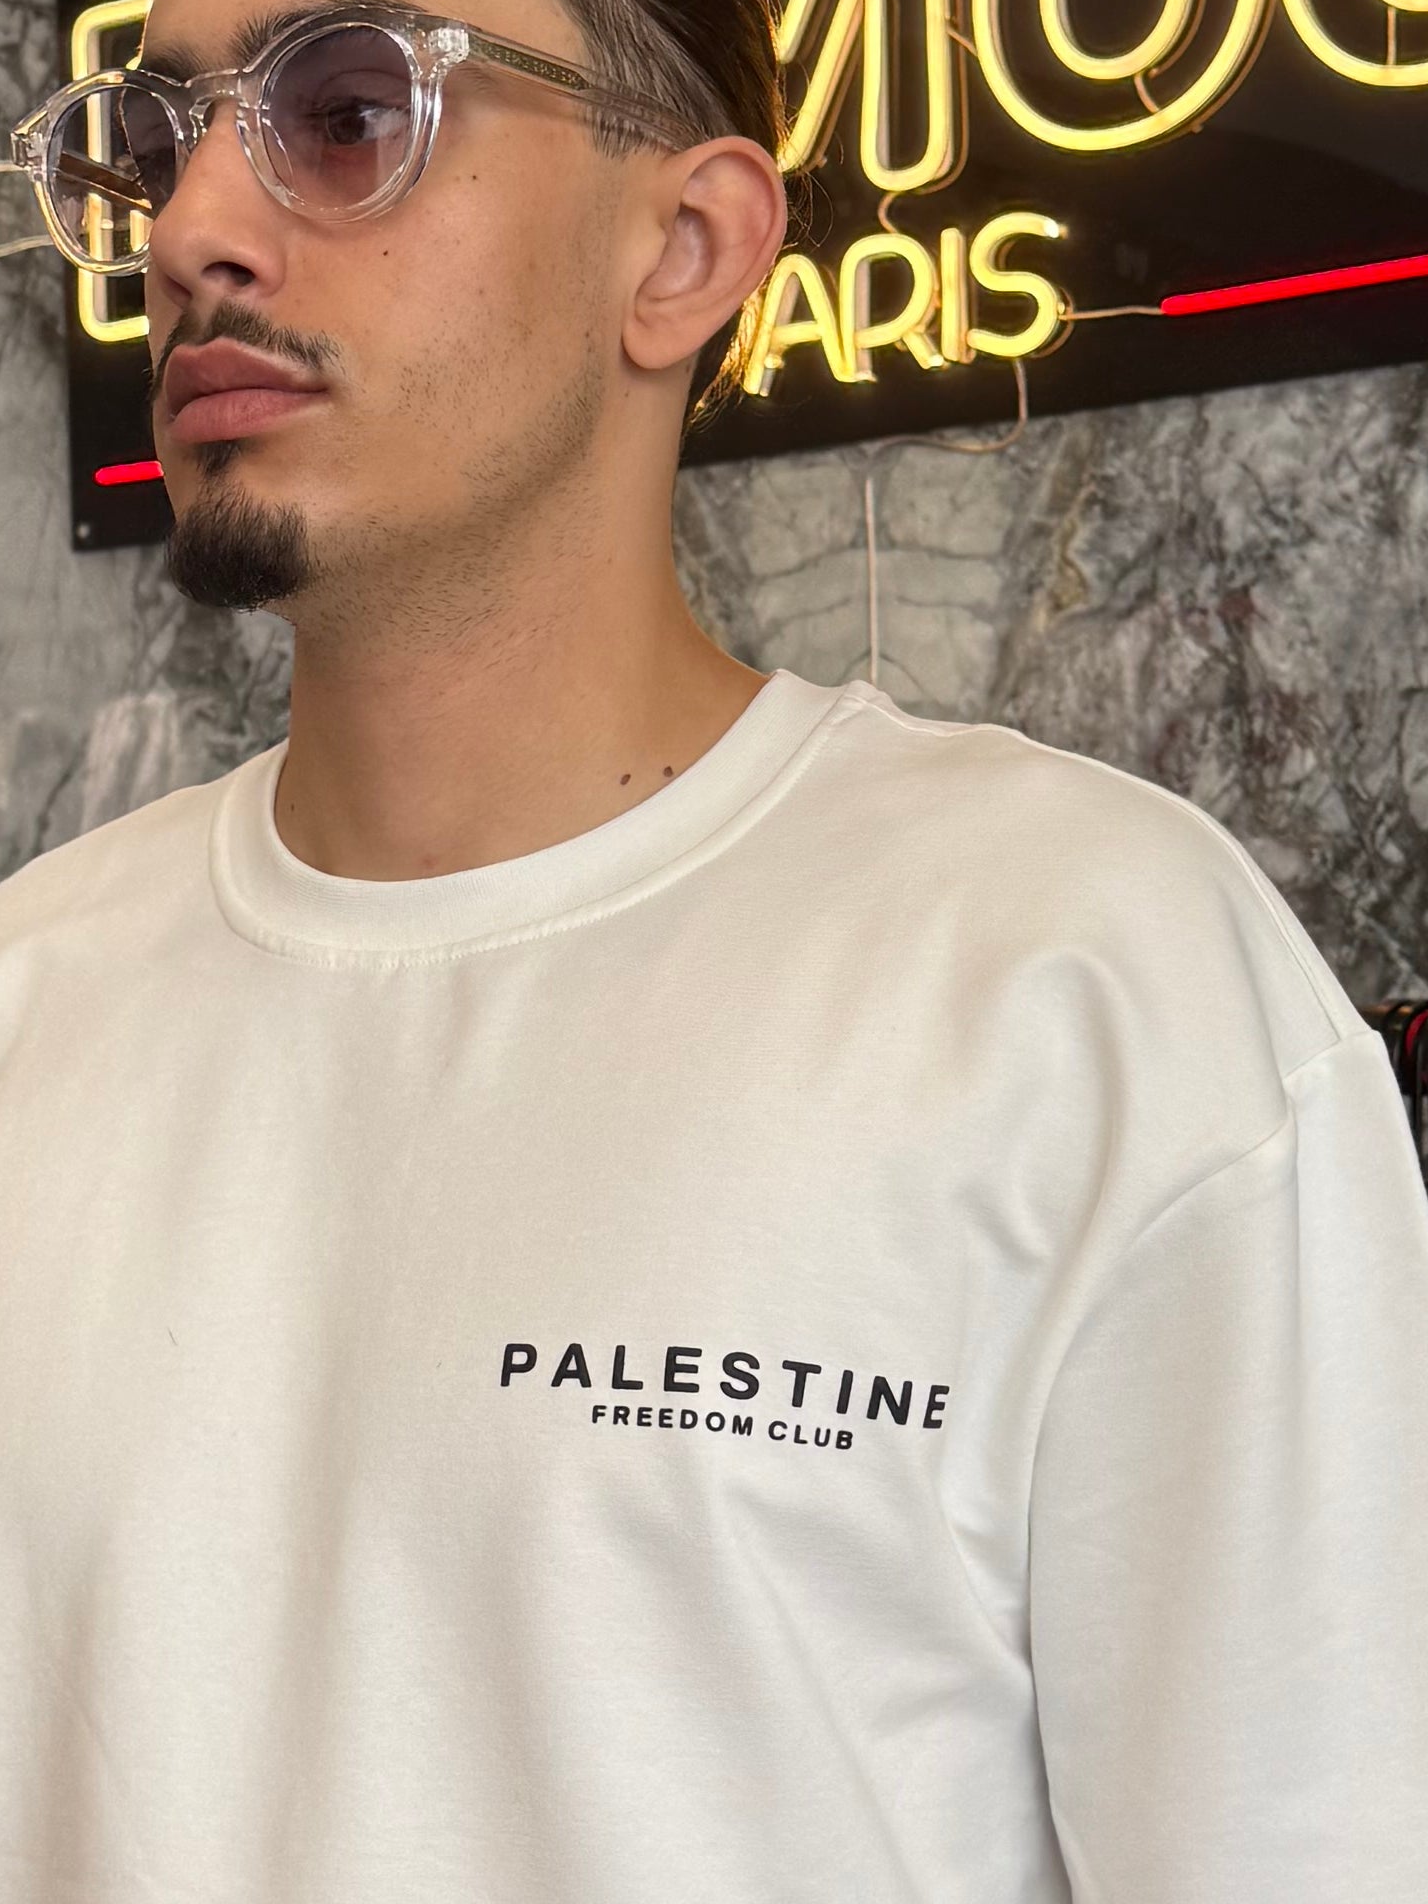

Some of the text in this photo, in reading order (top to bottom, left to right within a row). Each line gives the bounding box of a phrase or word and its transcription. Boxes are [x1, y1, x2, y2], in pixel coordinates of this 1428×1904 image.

[740, 211, 1068, 396] ARIS
[500, 1342, 951, 1429] PALESTINE
[591, 1404, 855, 1450] FREEDOM CLUB
